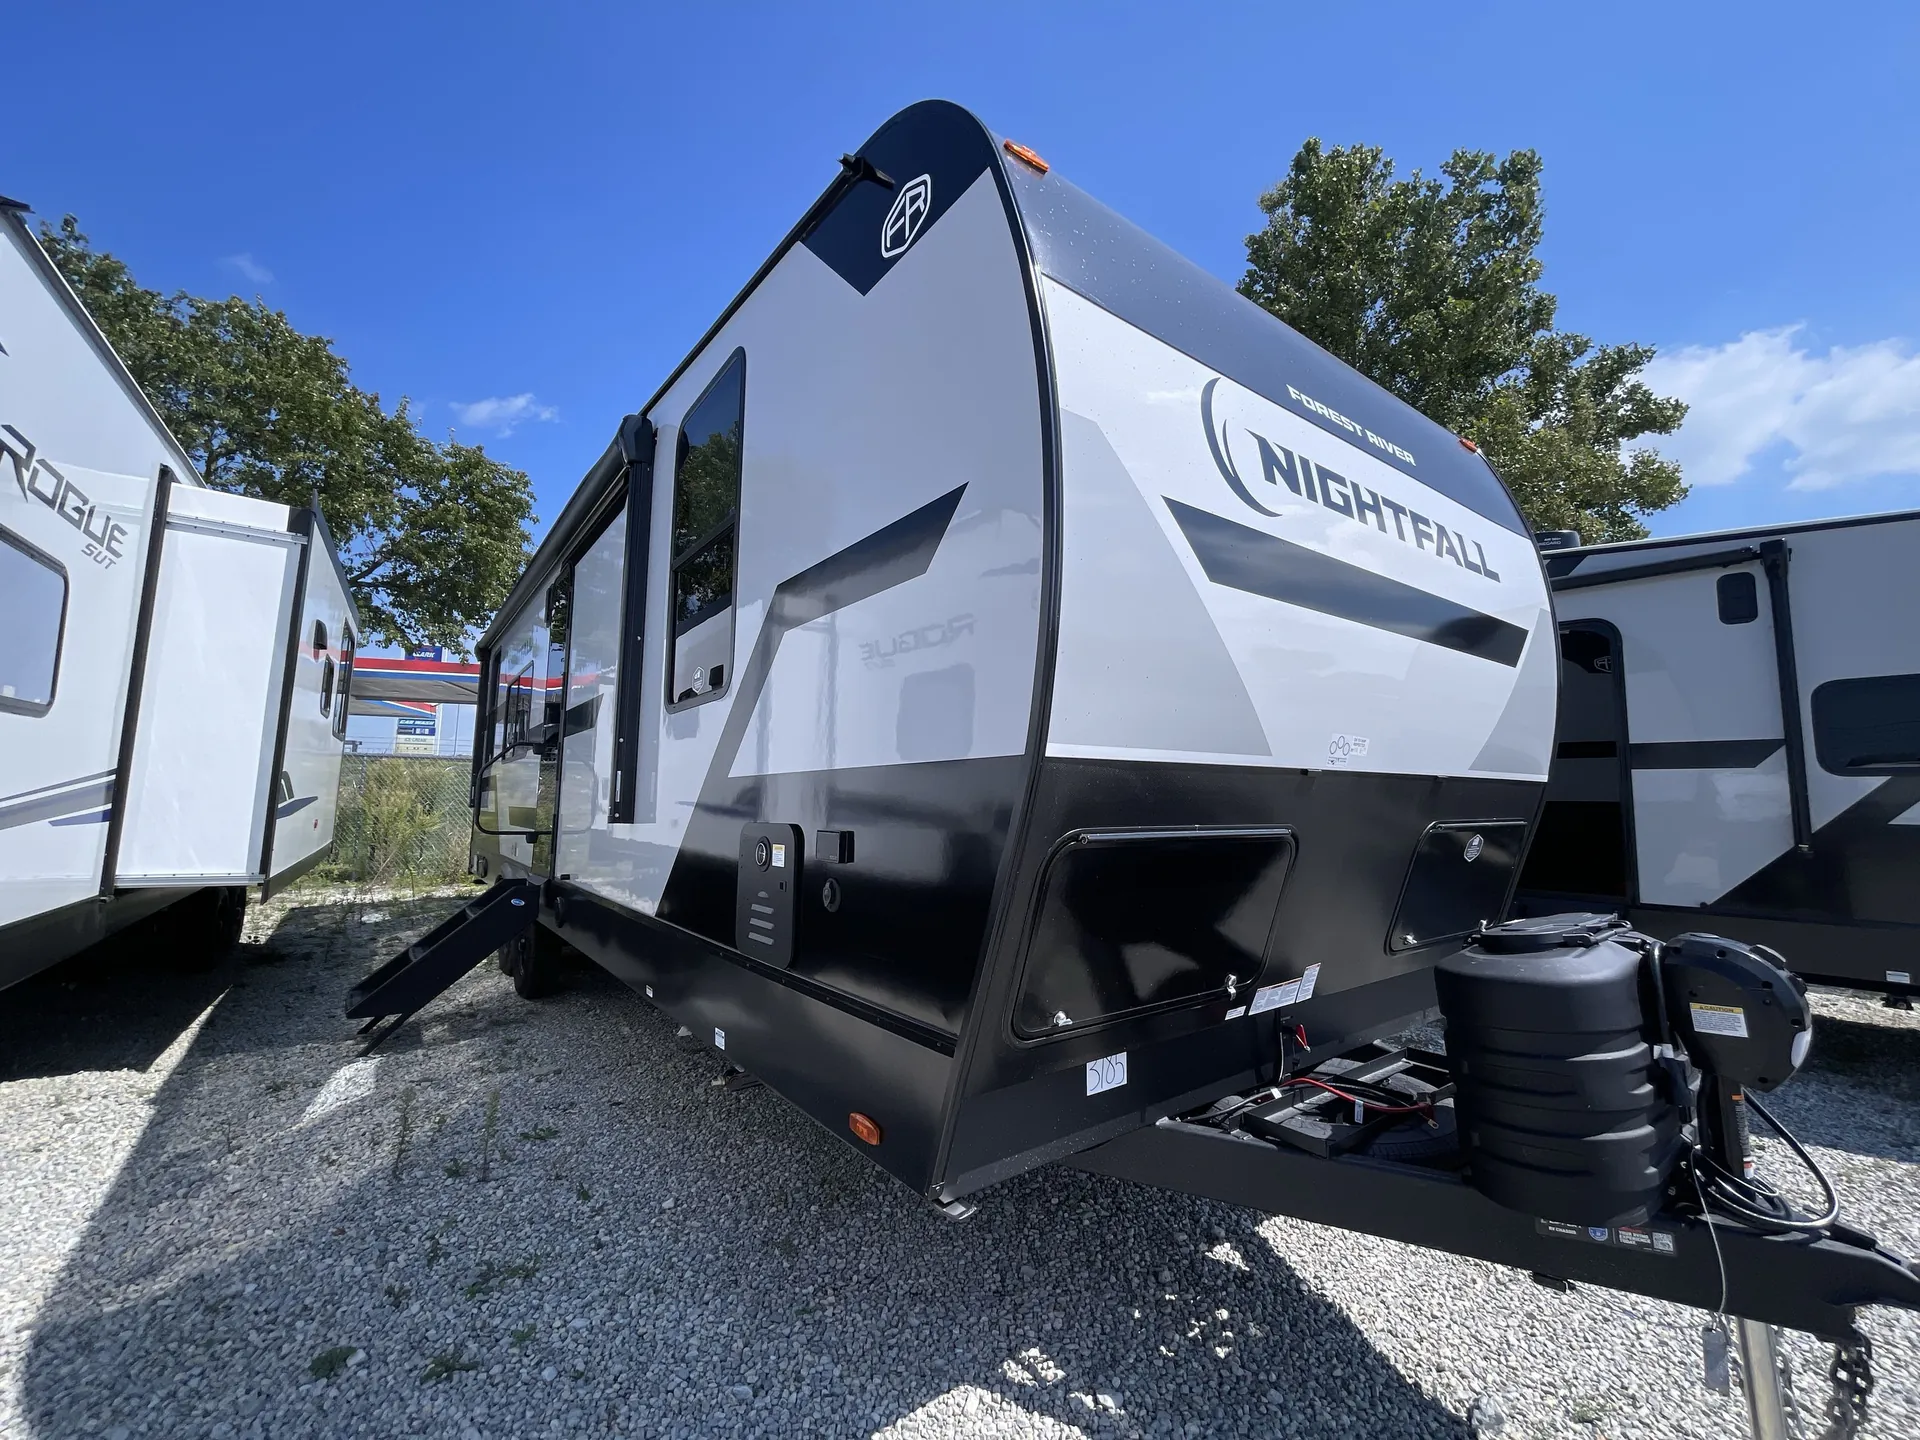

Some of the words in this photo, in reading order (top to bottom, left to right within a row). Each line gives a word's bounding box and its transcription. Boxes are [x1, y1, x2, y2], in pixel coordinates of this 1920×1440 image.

[1286, 383, 1363, 437] FOREST
[1364, 428, 1416, 467] RIVER
[0, 424, 129, 559] ROGUE
[1245, 427, 1501, 583] NIGHTFALL
[81, 542, 117, 570] SUT
[1704, 1005, 1734, 1013] CAUTION
